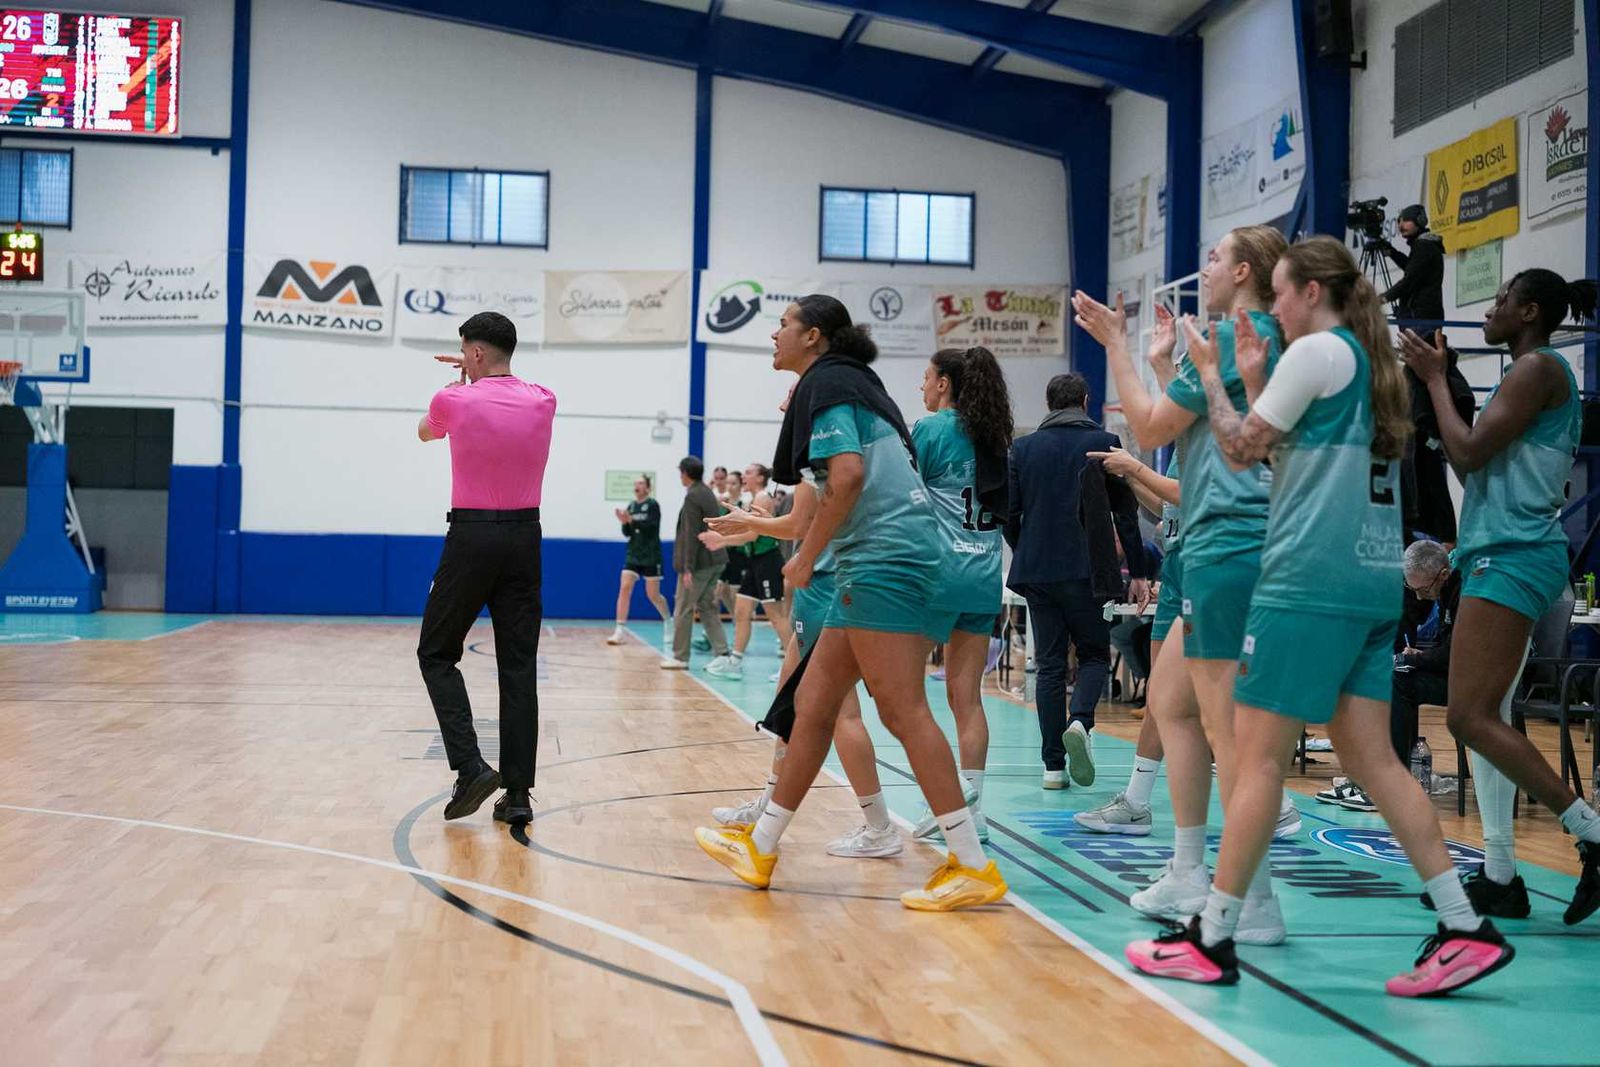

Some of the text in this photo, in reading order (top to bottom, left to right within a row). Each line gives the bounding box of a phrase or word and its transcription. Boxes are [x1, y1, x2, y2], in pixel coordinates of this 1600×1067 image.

[0, 251, 36, 276] 24
[124, 278, 219, 302] Ricardo
[253, 310, 383, 332] MANZANO
